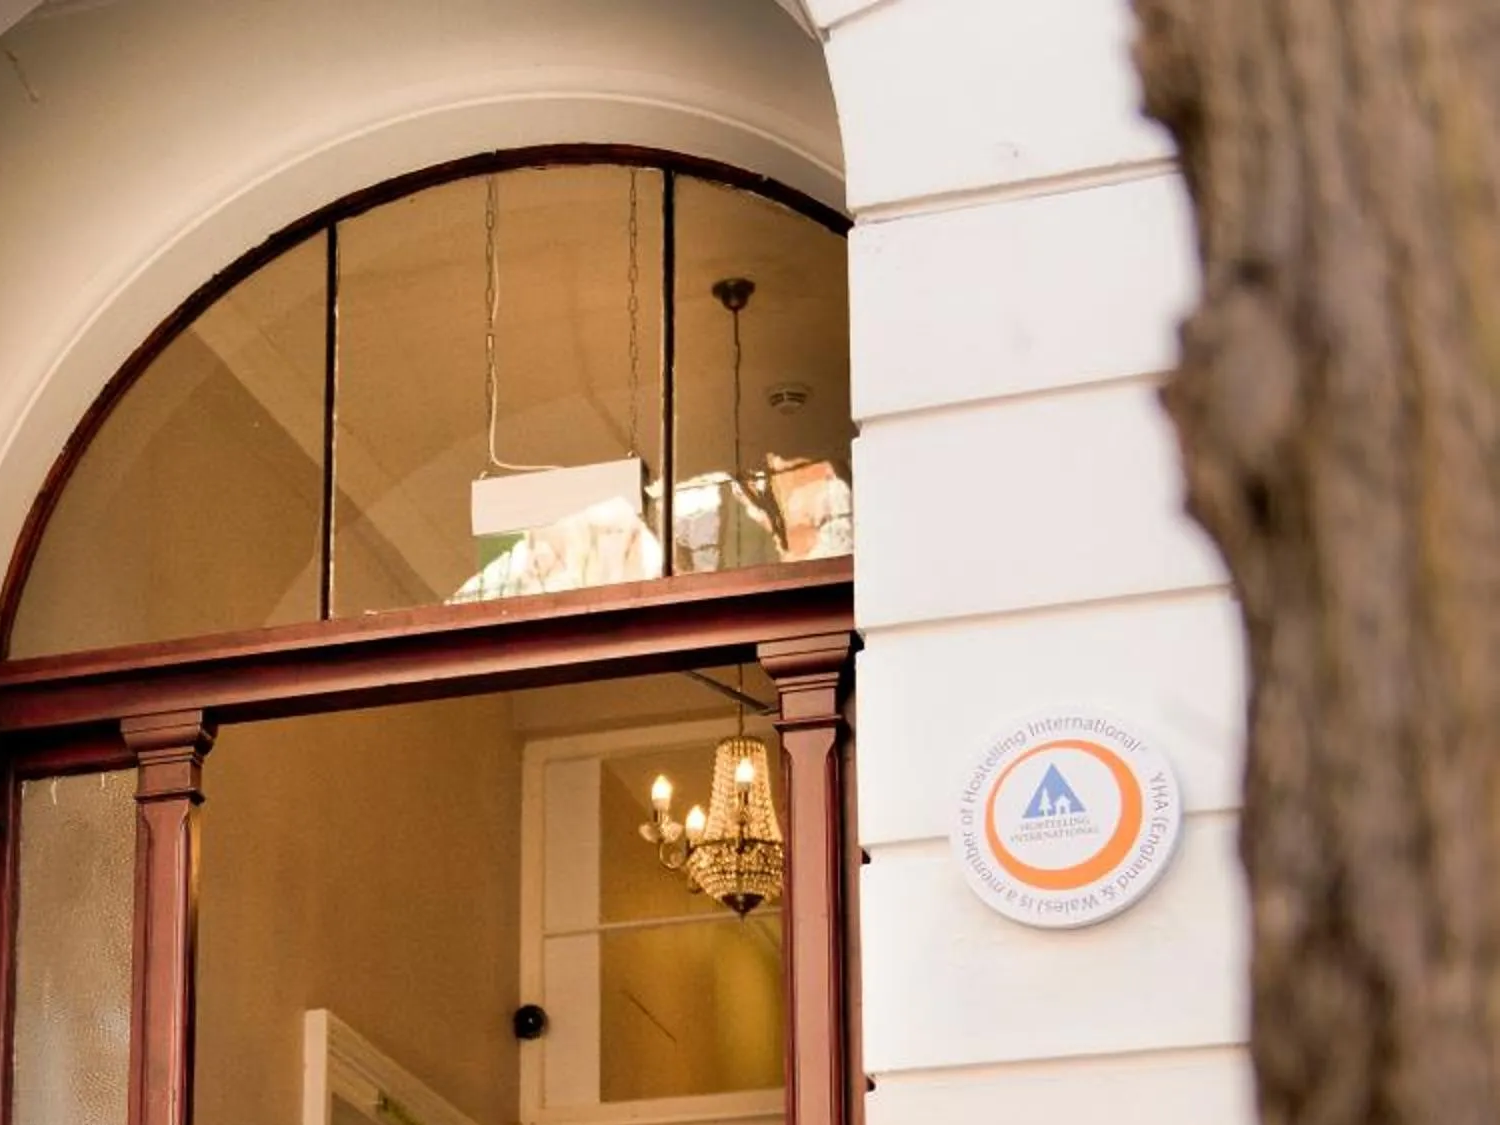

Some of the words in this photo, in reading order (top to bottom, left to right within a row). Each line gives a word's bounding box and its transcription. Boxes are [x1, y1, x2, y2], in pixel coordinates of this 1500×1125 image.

[962, 729, 1028, 804] Hostelling
[1150, 771, 1169, 811] YHA
[960, 807, 973, 826] of
[963, 831, 1006, 894] member
[1116, 817, 1170, 890] (England
[1037, 895, 1101, 914] Wales)
[1100, 885, 1118, 901] &
